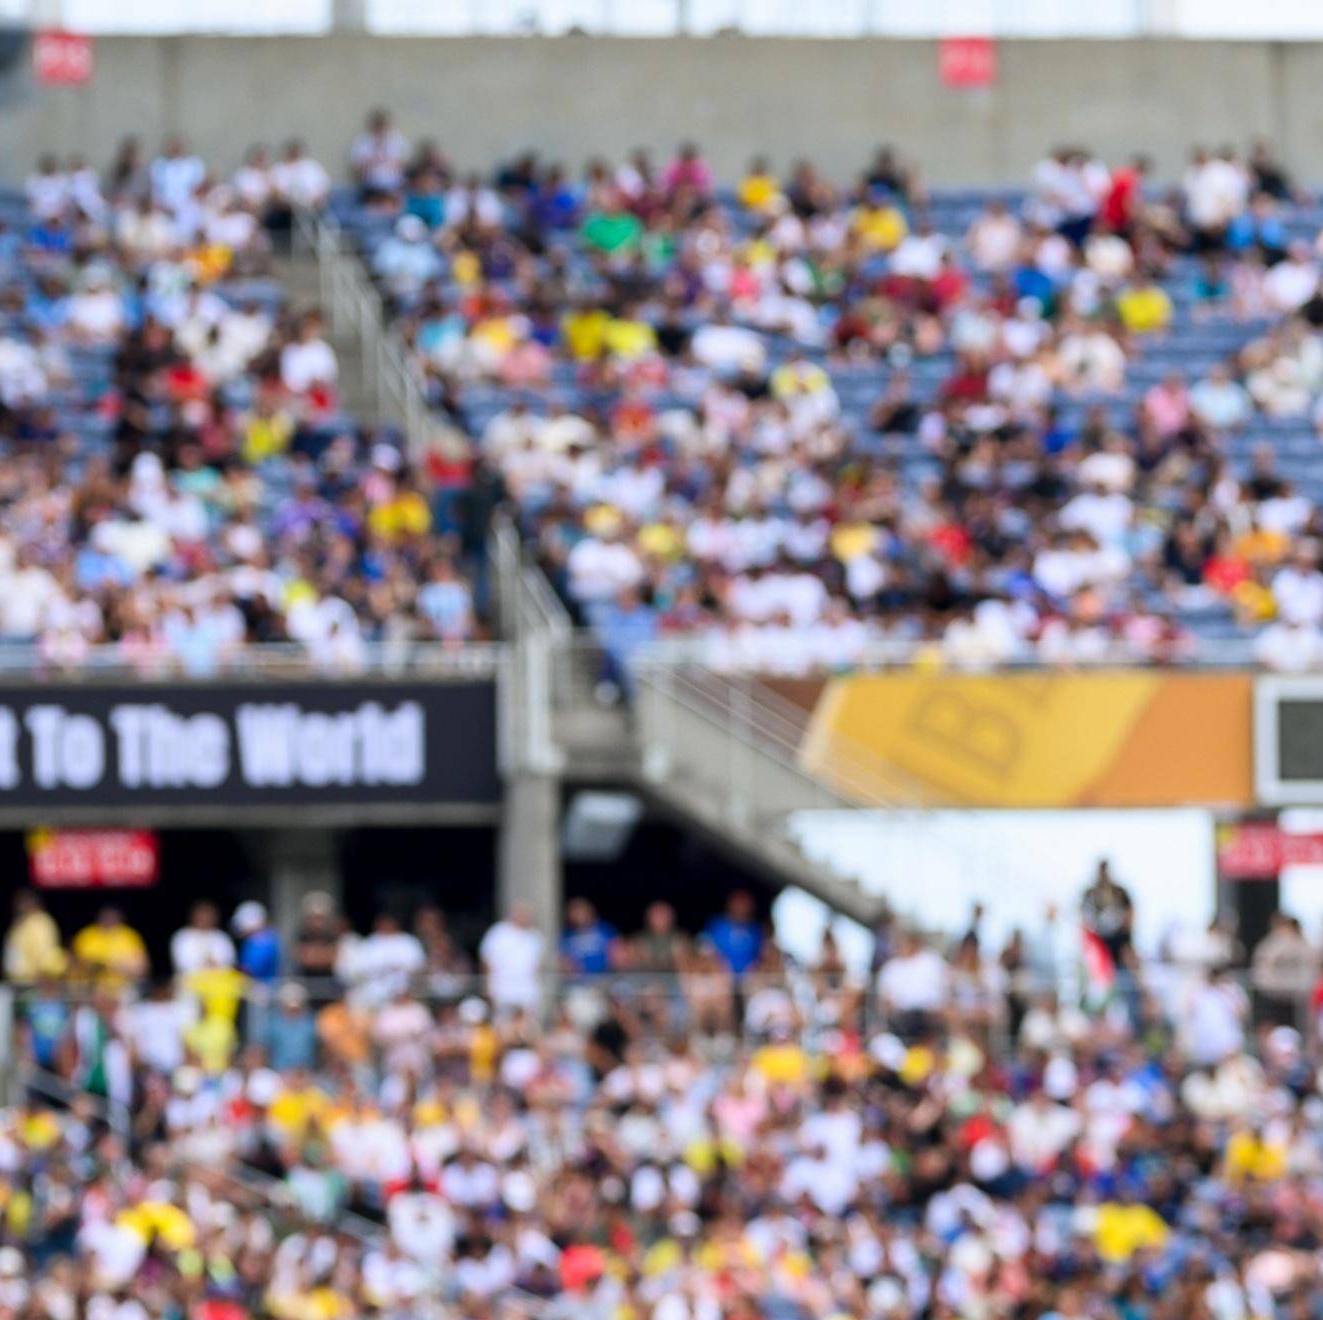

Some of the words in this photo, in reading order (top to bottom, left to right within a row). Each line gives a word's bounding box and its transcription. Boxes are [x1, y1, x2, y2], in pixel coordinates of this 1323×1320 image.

[25, 705, 106, 790] To
[110, 704, 229, 789] The
[235, 702, 425, 787] World
